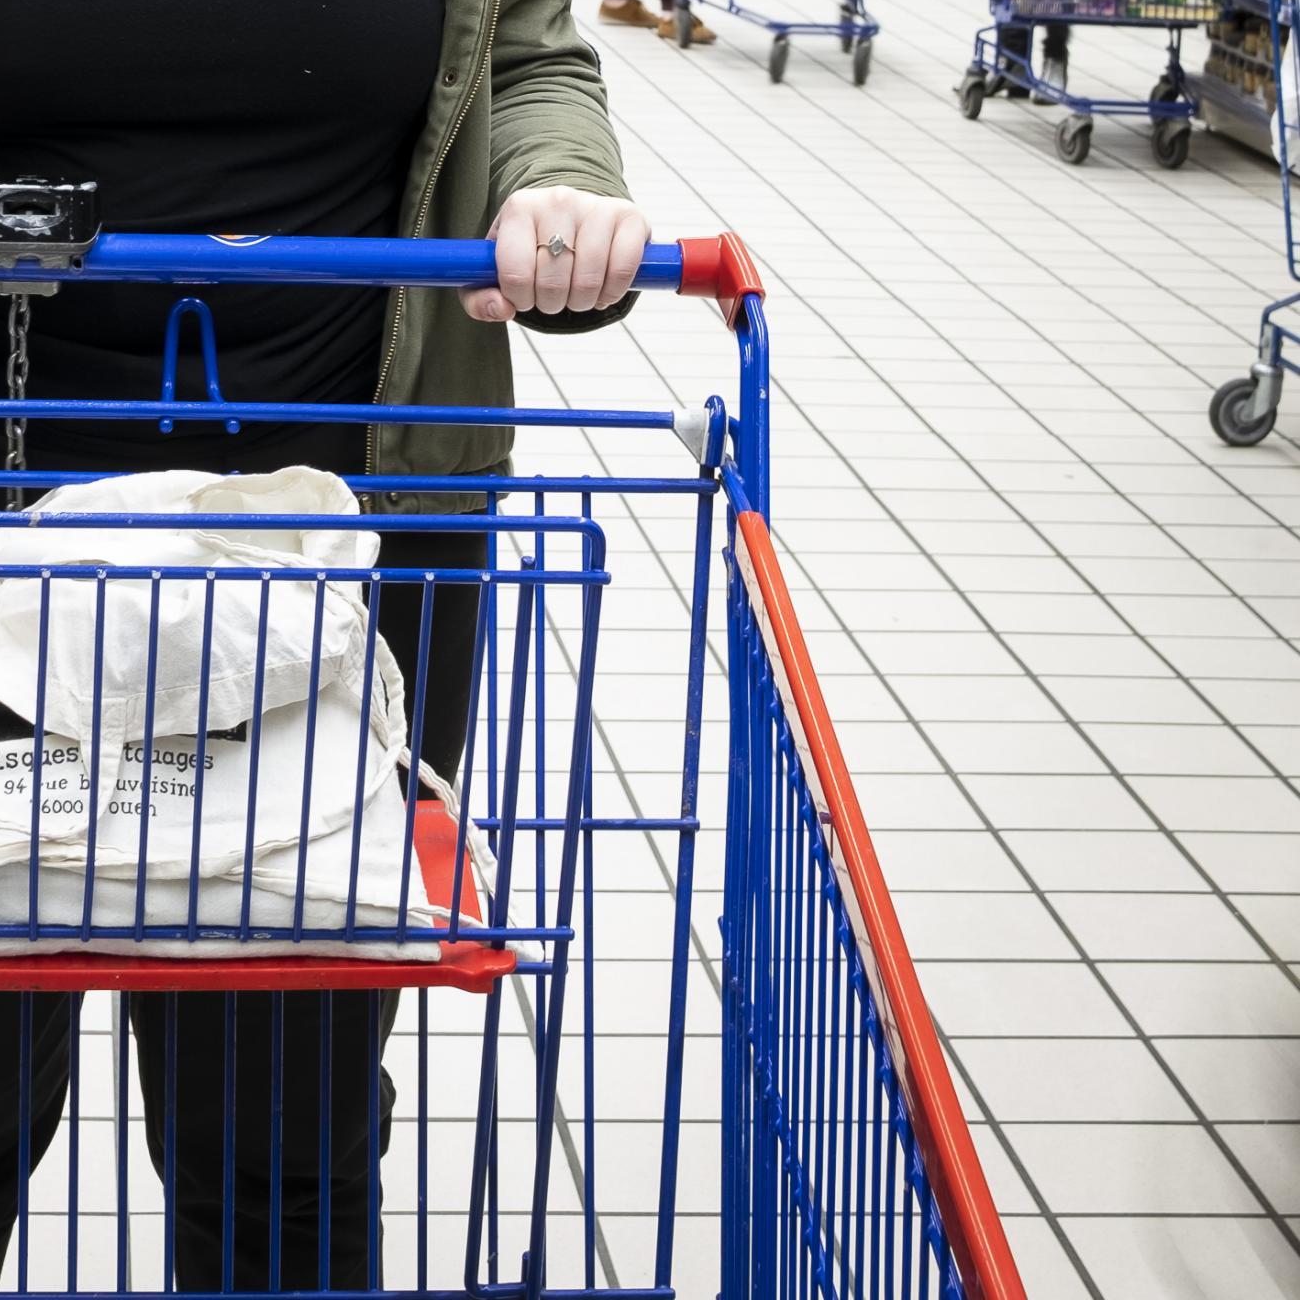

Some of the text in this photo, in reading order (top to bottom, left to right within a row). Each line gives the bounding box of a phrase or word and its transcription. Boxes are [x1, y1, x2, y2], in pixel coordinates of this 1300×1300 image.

[3, 777, 28, 795] 94
[40, 778, 68, 791] ue
[29, 798, 157, 817] 6000 ouen
